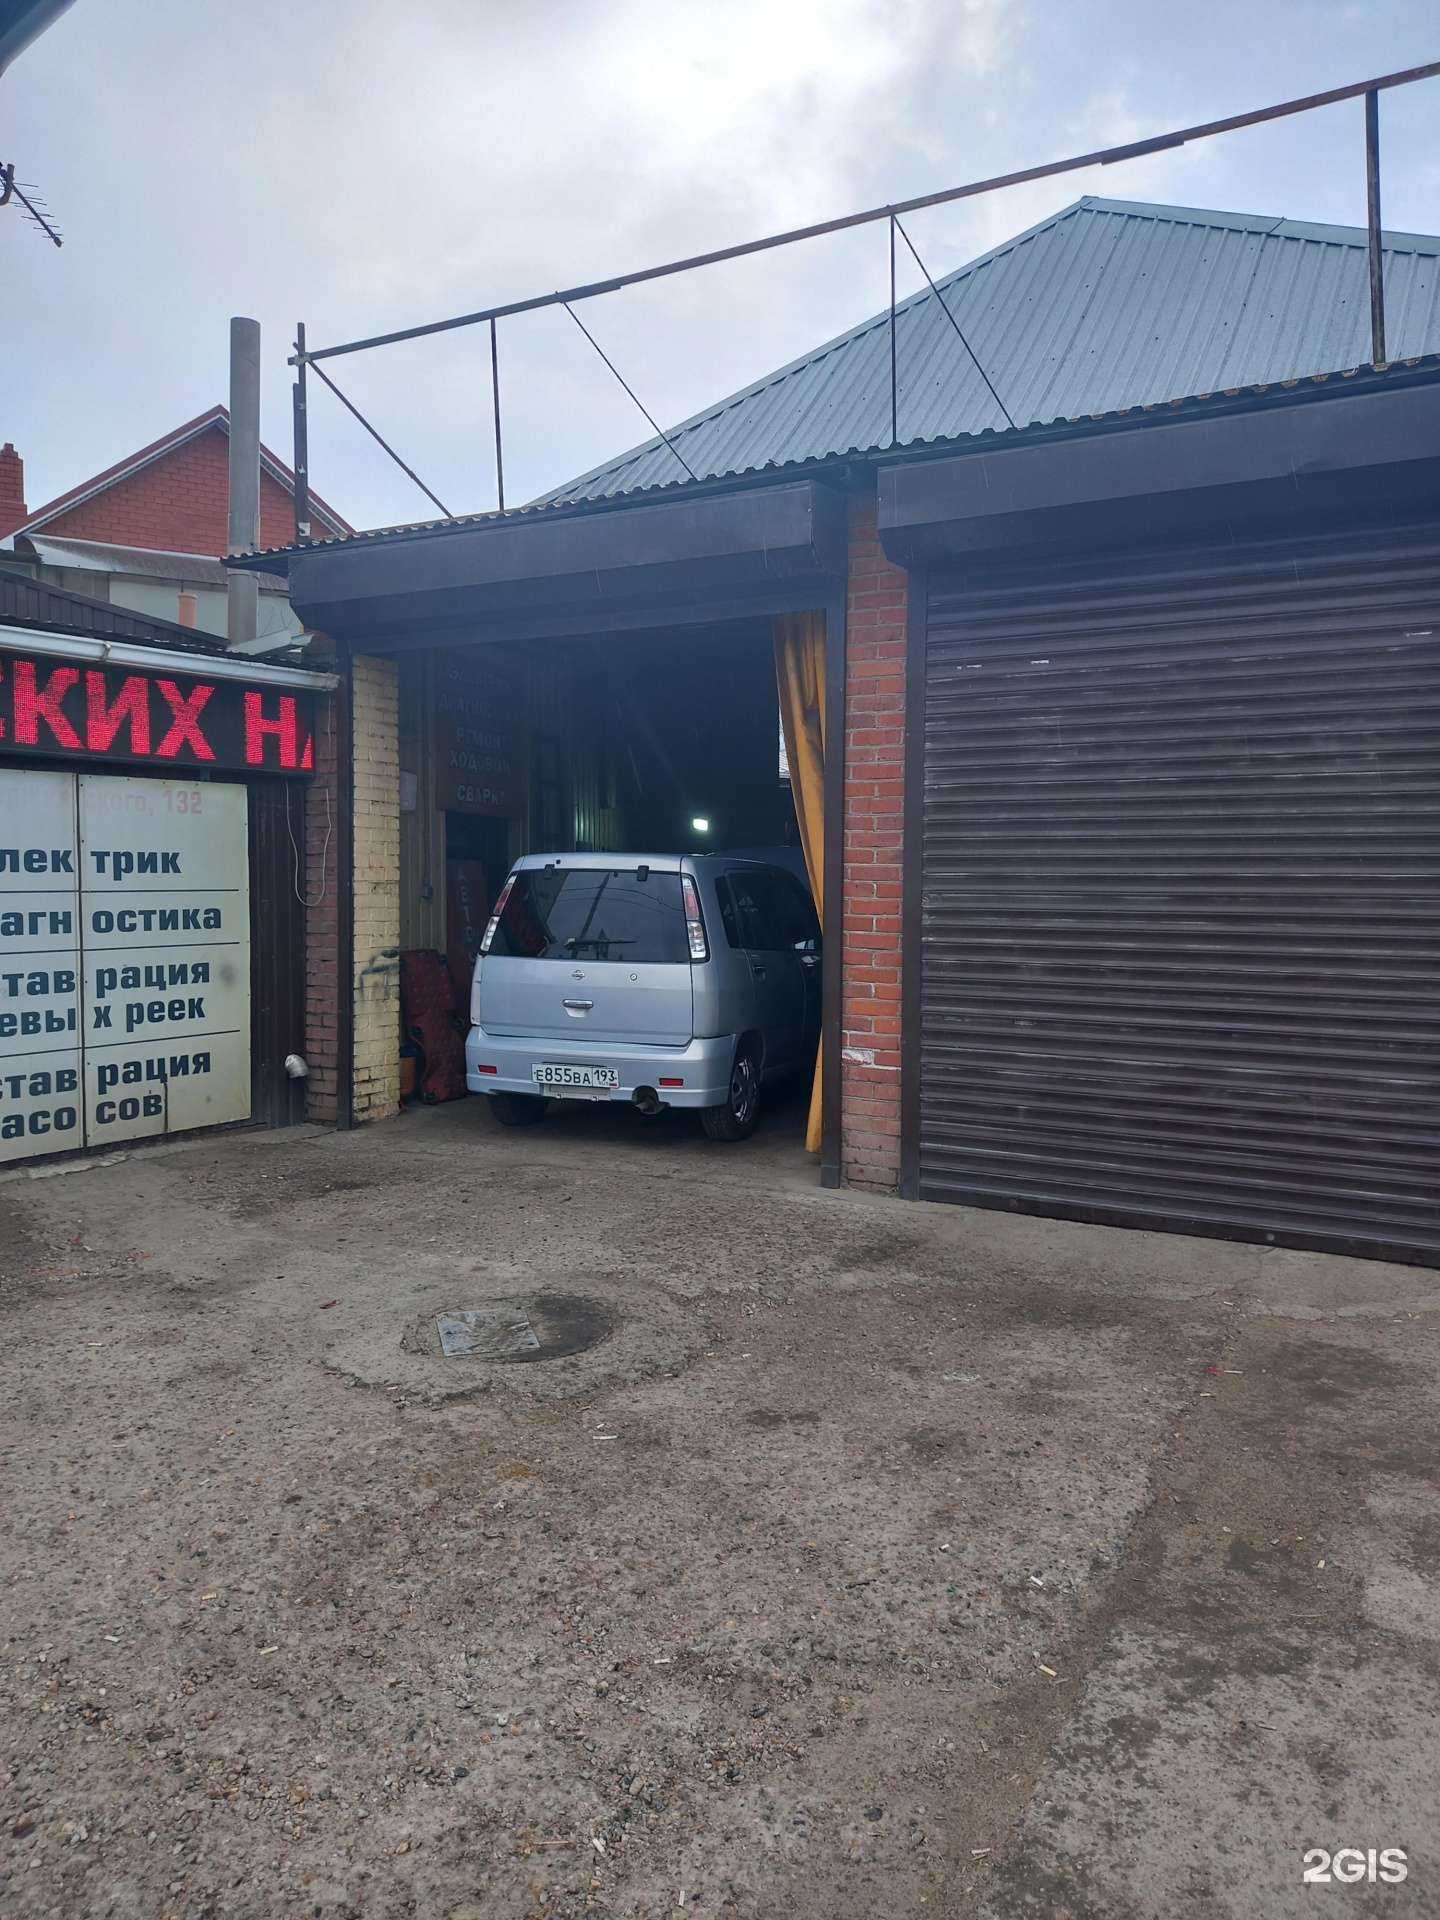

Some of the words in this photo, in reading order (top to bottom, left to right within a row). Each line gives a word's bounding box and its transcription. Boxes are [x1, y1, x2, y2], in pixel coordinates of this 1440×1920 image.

[0, 660, 216, 760] КИХ
[164, 790, 202, 815] 132
[126, 997, 206, 1032] реек
